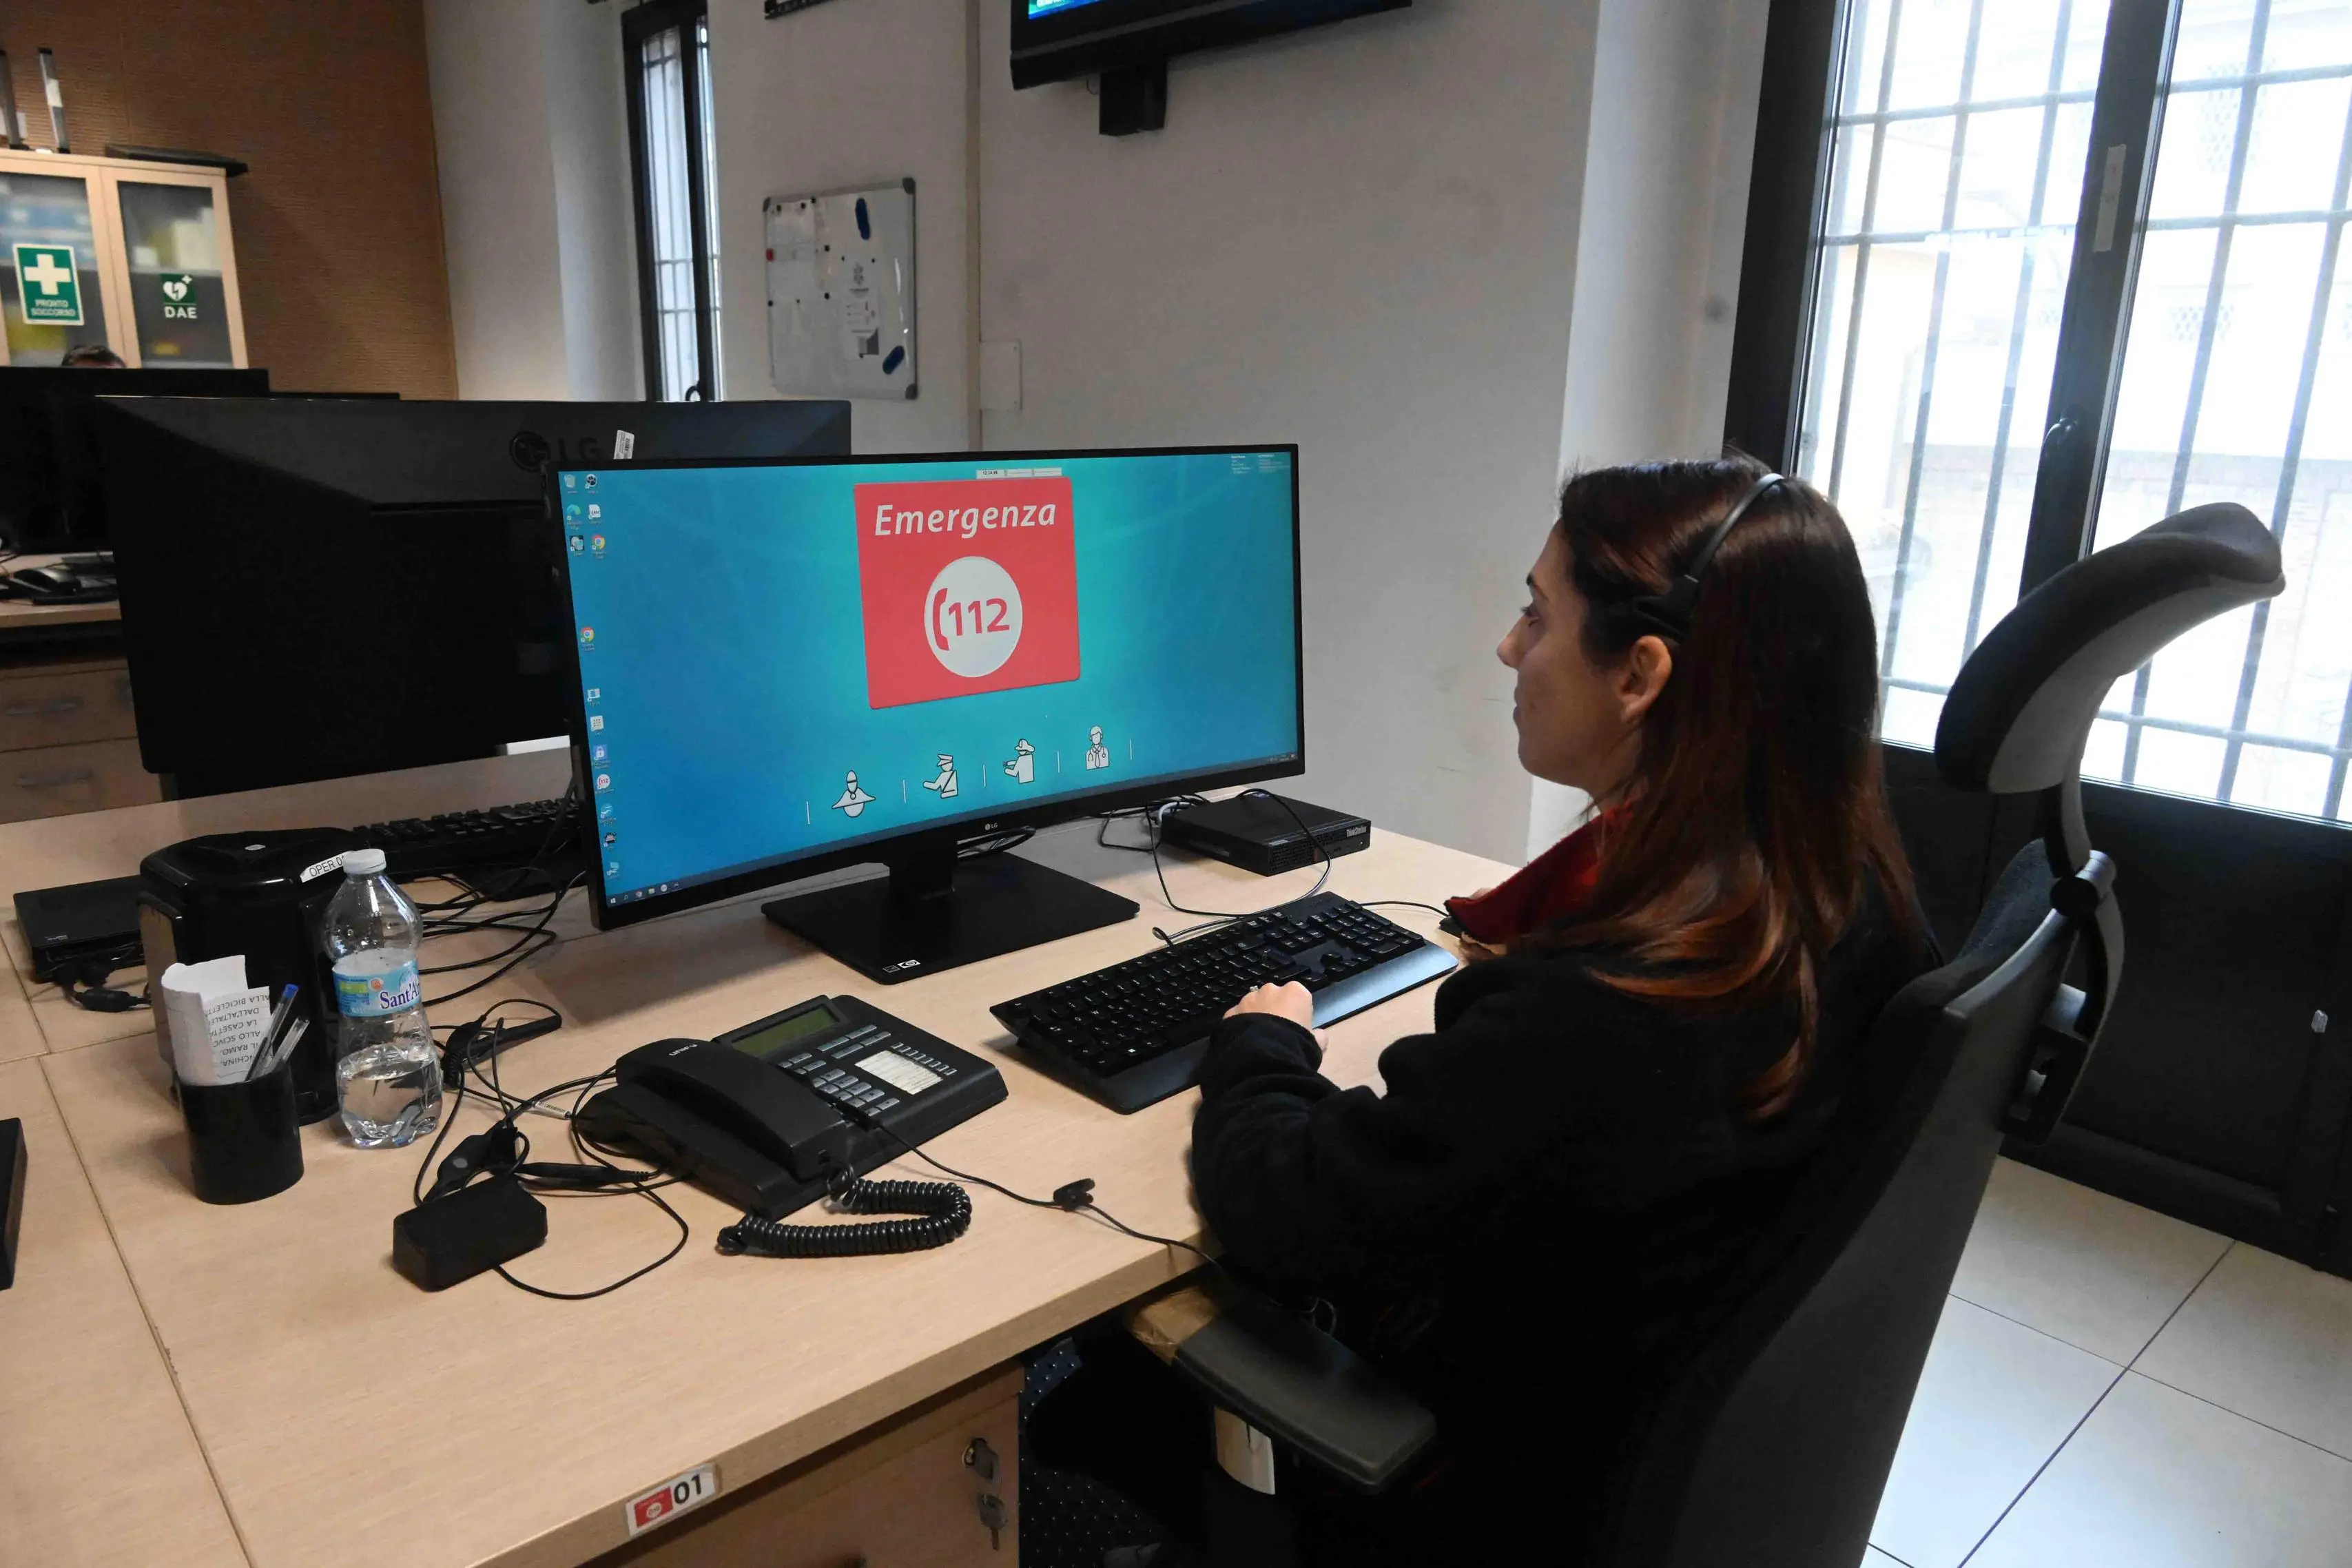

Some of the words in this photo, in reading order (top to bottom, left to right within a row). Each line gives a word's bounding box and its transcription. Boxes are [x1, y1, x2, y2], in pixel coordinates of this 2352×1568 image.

[164, 307, 197, 318] DAE
[874, 504, 1056, 539] Emergenza
[948, 597, 1010, 637] 112
[309, 860, 335, 877] OPER
[239, 1031, 260, 1040] ALLO
[674, 1474, 702, 1504] 01
